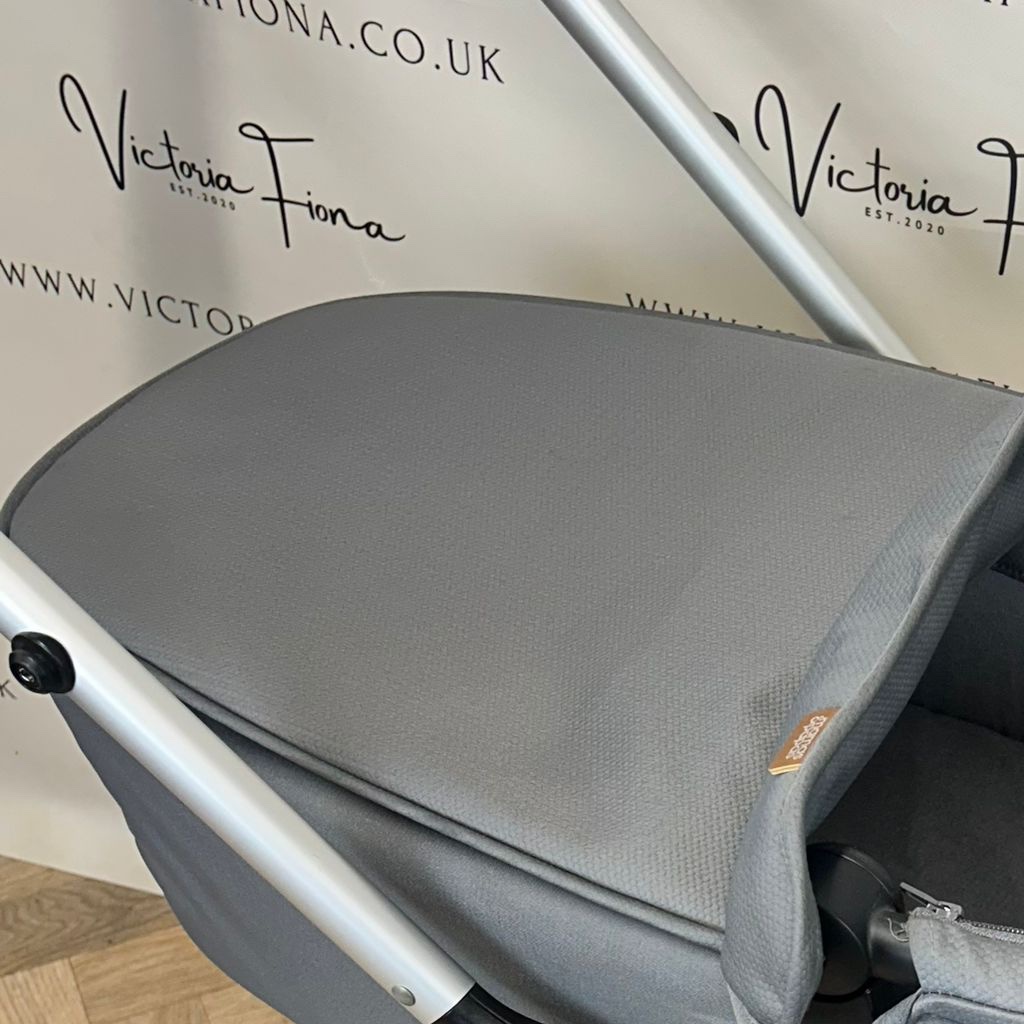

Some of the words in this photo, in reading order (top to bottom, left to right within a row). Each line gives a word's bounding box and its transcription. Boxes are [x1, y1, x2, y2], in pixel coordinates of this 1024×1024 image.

[59, 74, 254, 191] Victoria
[239, 122, 406, 248] Fiona
[754, 84, 978, 217] Victoria
[865, 206, 945, 236] EST.2020
